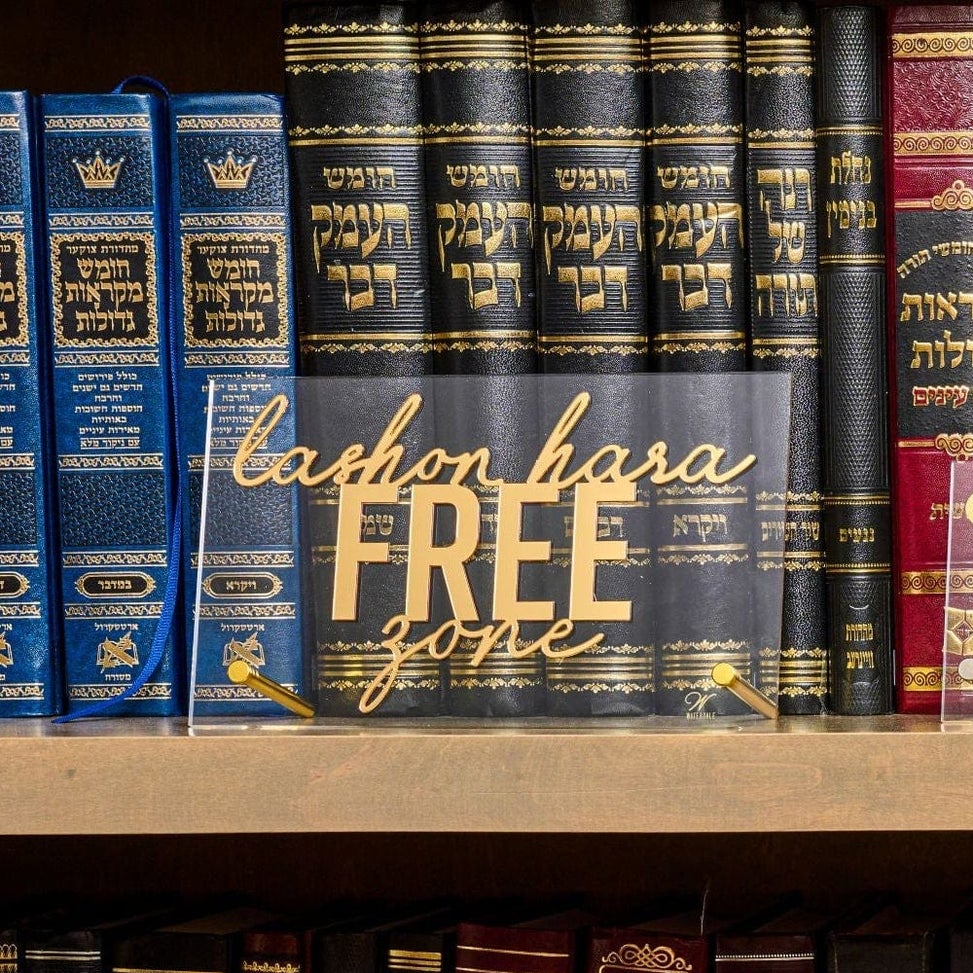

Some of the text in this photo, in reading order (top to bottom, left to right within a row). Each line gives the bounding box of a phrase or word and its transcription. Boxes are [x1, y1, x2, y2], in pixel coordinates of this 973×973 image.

[324, 166, 398, 190] חומש
[446, 165, 521, 188] חומש
[555, 166, 628, 191] חומש
[657, 165, 730, 189] חומש
[831, 151, 871, 185] נחלת
[765, 200, 805, 264] של
[826, 200, 877, 238] בנימין
[67, 244, 138, 254] מהדורת צוקער
[311, 201, 411, 274] העמק
[436, 199, 534, 273] העמק
[542, 202, 643, 276] העמק
[197, 245, 269, 254] מהדורת צוקער
[78, 258, 130, 279] חומש
[208, 258, 260, 279] חומש
[897, 249, 931, 279] תורה
[66, 281, 143, 311] מקראות
[195, 281, 274, 311] מקראות
[327, 263, 397, 311] דבר
[451, 262, 521, 310] דבר
[557, 264, 627, 314] דבר
[661, 263, 732, 311] דבר
[76, 310, 136, 333] גדולות
[206, 310, 265, 333] גדולות
[116, 371, 137, 380] כולל
[912, 385, 969, 408] עינים
[92, 416, 127, 424] באותיות
[81, 438, 99, 447] מלא
[233, 391, 756, 487] lashon hara
[673, 514, 729, 541] ויקרא
[331, 483, 638, 623] FREE
[98, 580, 131, 590] במדבר
[226, 580, 257, 591] ויקרא
[360, 614, 606, 713] zone
[105, 673, 131, 681] מסורה
